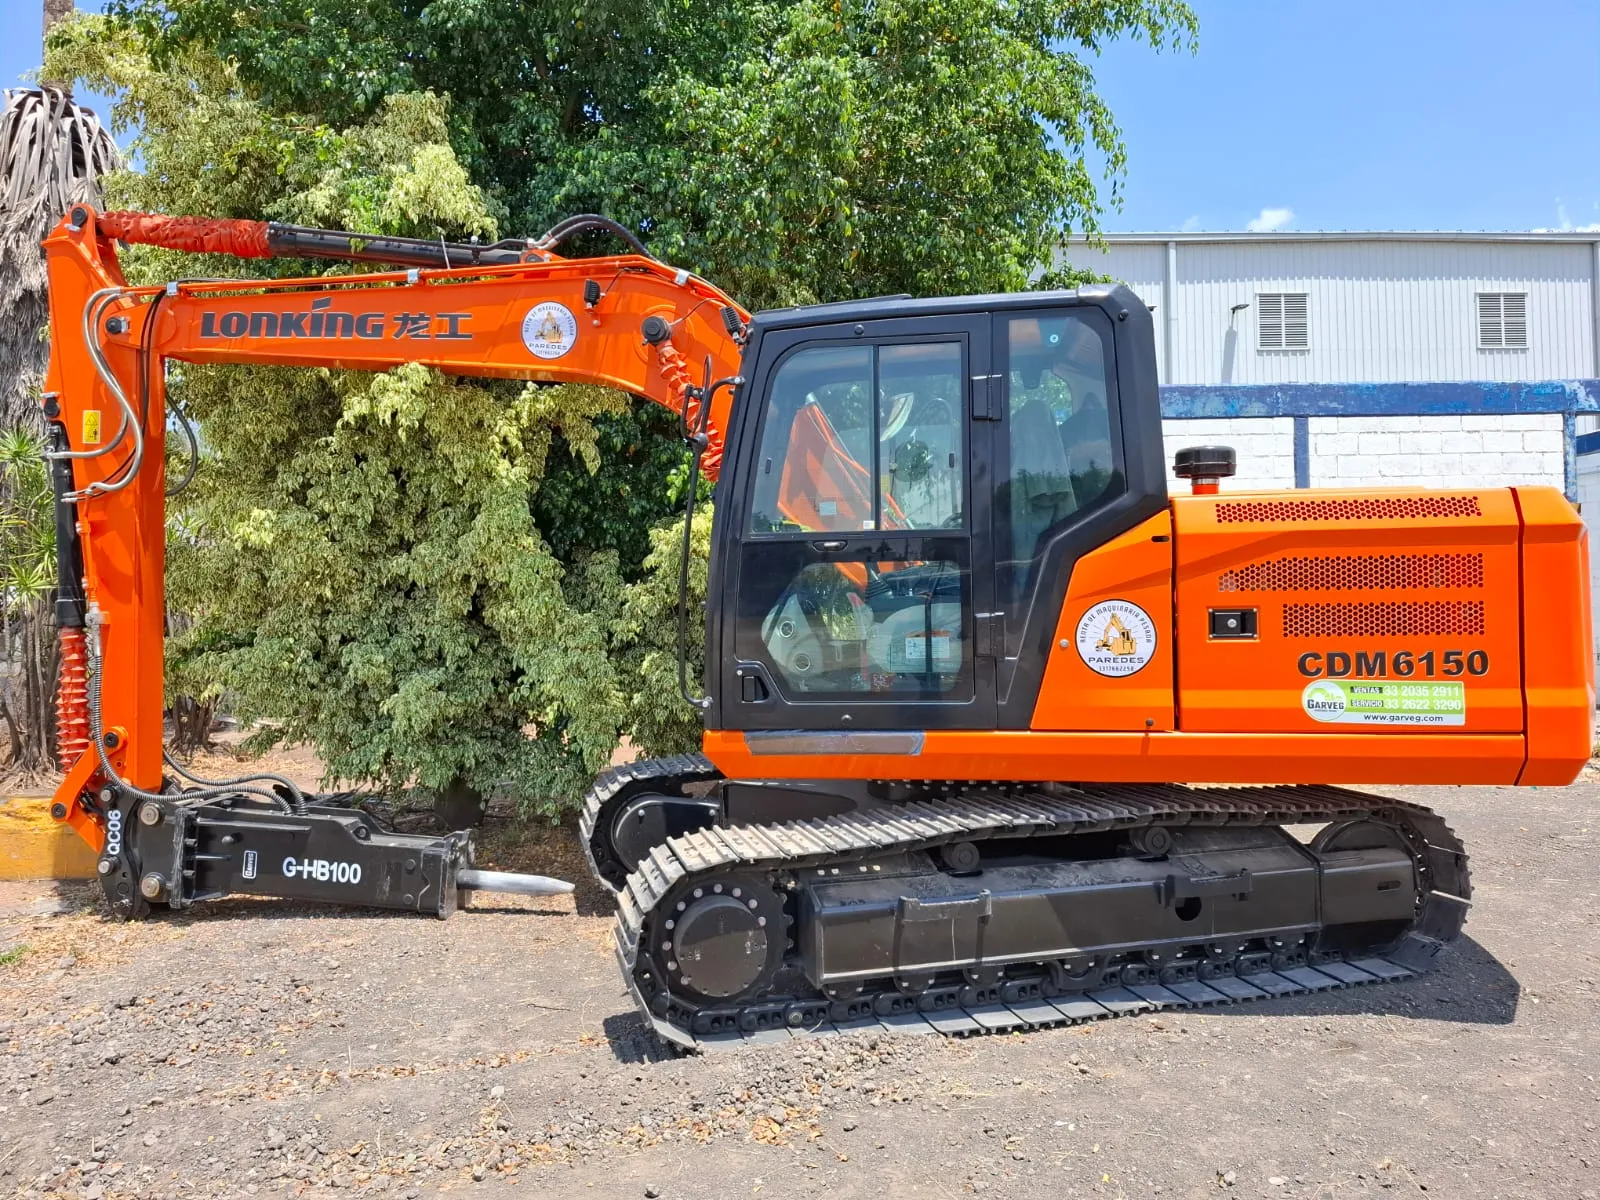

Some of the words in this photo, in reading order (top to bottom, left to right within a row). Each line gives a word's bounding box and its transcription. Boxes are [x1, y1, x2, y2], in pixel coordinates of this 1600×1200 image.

[392, 312, 473, 340] 龙工
[1087, 614, 1096, 622] DE
[1298, 650, 1489, 678] CDM6150
[1353, 686, 1381, 694] VENTAS
[1384, 685, 1398, 696] 33
[1401, 686, 1429, 697] 2035
[1432, 686, 1459, 697] 2911
[1352, 700, 1383, 708] SERVICIO
[1385, 699, 1399, 710] 33
[1402, 699, 1430, 710] 2622
[1433, 700, 1461, 711] 3290
[1363, 713, 1444, 722] www.garveg.com
[107, 809, 121, 855] QC06
[282, 856, 362, 884] G-HB100
